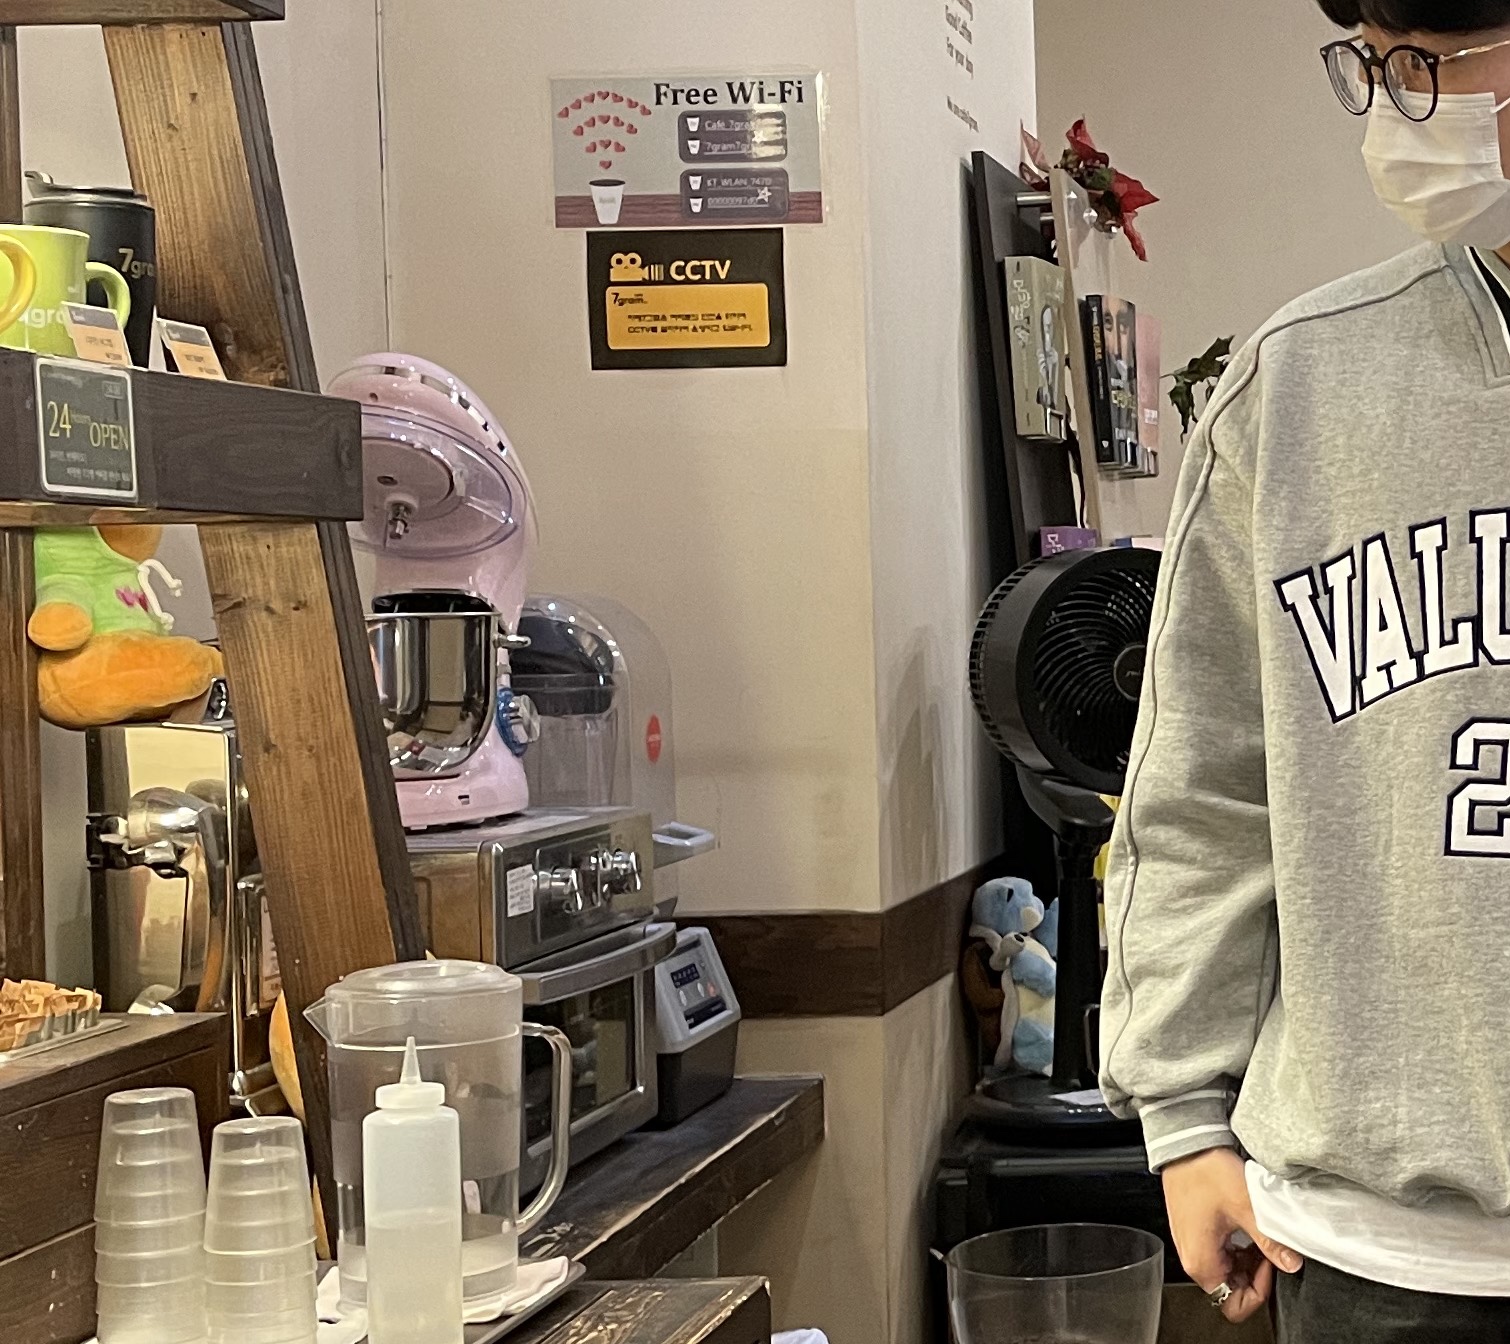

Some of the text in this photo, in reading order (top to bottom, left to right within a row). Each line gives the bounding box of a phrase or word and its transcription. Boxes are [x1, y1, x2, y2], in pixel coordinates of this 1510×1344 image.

[653, 80, 804, 105] Free Wi-Fi
[669, 259, 732, 281] CCTV
[47, 400, 129, 451] 24 OPEN
